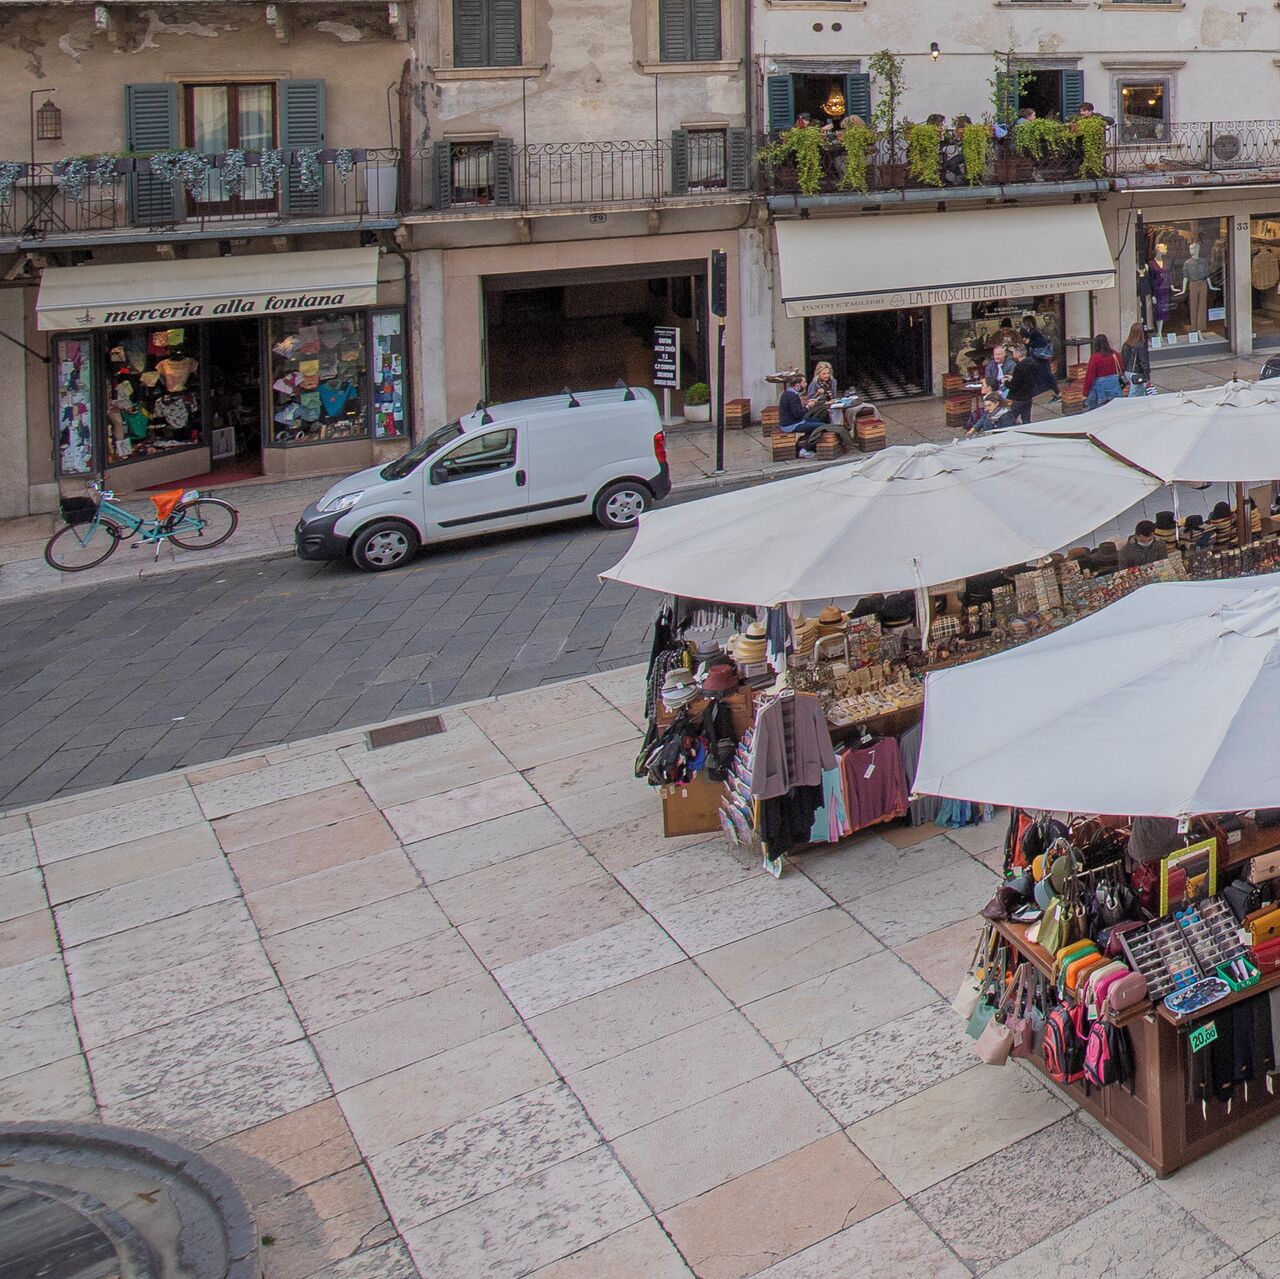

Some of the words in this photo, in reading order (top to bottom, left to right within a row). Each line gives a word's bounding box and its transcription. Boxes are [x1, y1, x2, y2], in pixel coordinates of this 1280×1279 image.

[1236, 222, 1249, 231] 33
[909, 293, 924, 305] LA
[927, 284, 1007, 303] PROSCIUTTERIA
[104, 302, 203, 324] merceria
[213, 299, 256, 315] alla
[264, 293, 345, 311] fontana
[802, 303, 834, 311] PANINI
[842, 298, 885, 308] TAGLIERI
